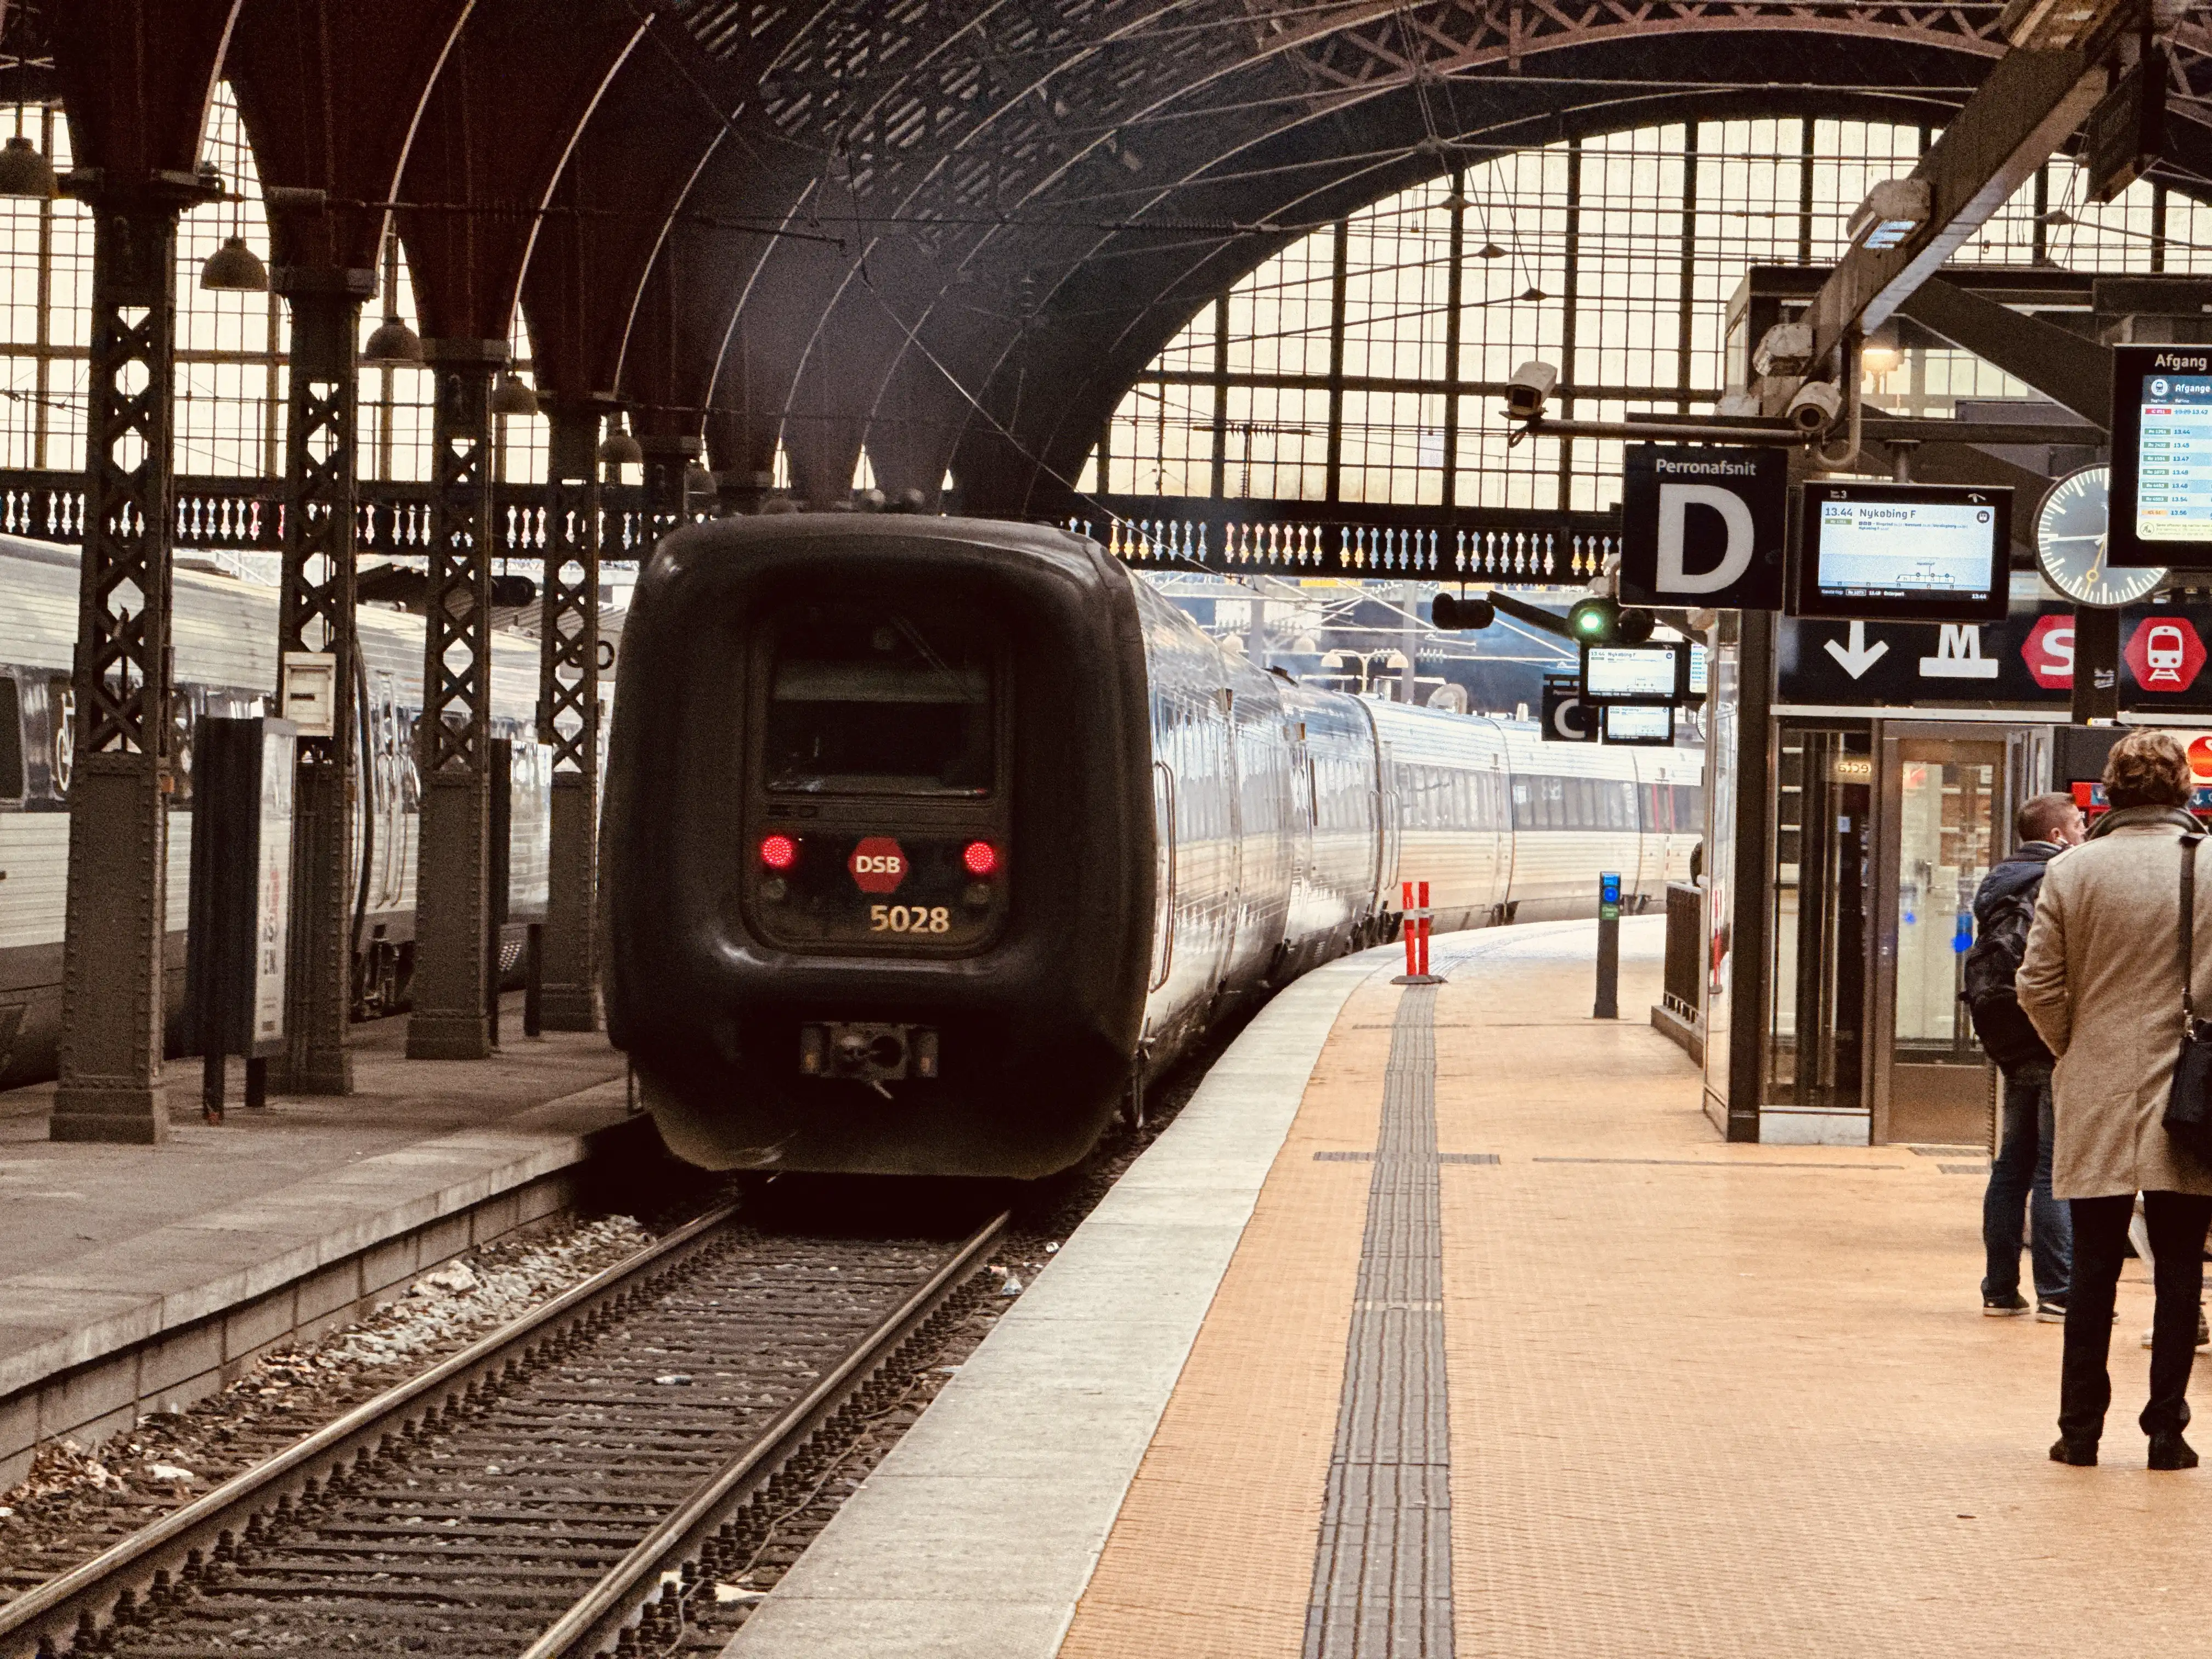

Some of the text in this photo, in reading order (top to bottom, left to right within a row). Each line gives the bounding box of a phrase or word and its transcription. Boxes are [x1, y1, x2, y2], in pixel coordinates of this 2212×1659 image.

[2154, 353, 2208, 371] Afgang
[2175, 383, 2211, 394] Afgange
[1655, 459, 1757, 476] Perronafsnit
[1840, 490, 1847, 499] 3
[1825, 507, 1853, 516] 13.44
[1910, 510, 1916, 518] F
[1656, 483, 1754, 594] D
[2040, 628, 2074, 675] S
[1554, 698, 1586, 739] C
[856, 856, 901, 873] DSB
[870, 905, 950, 933] 5028
